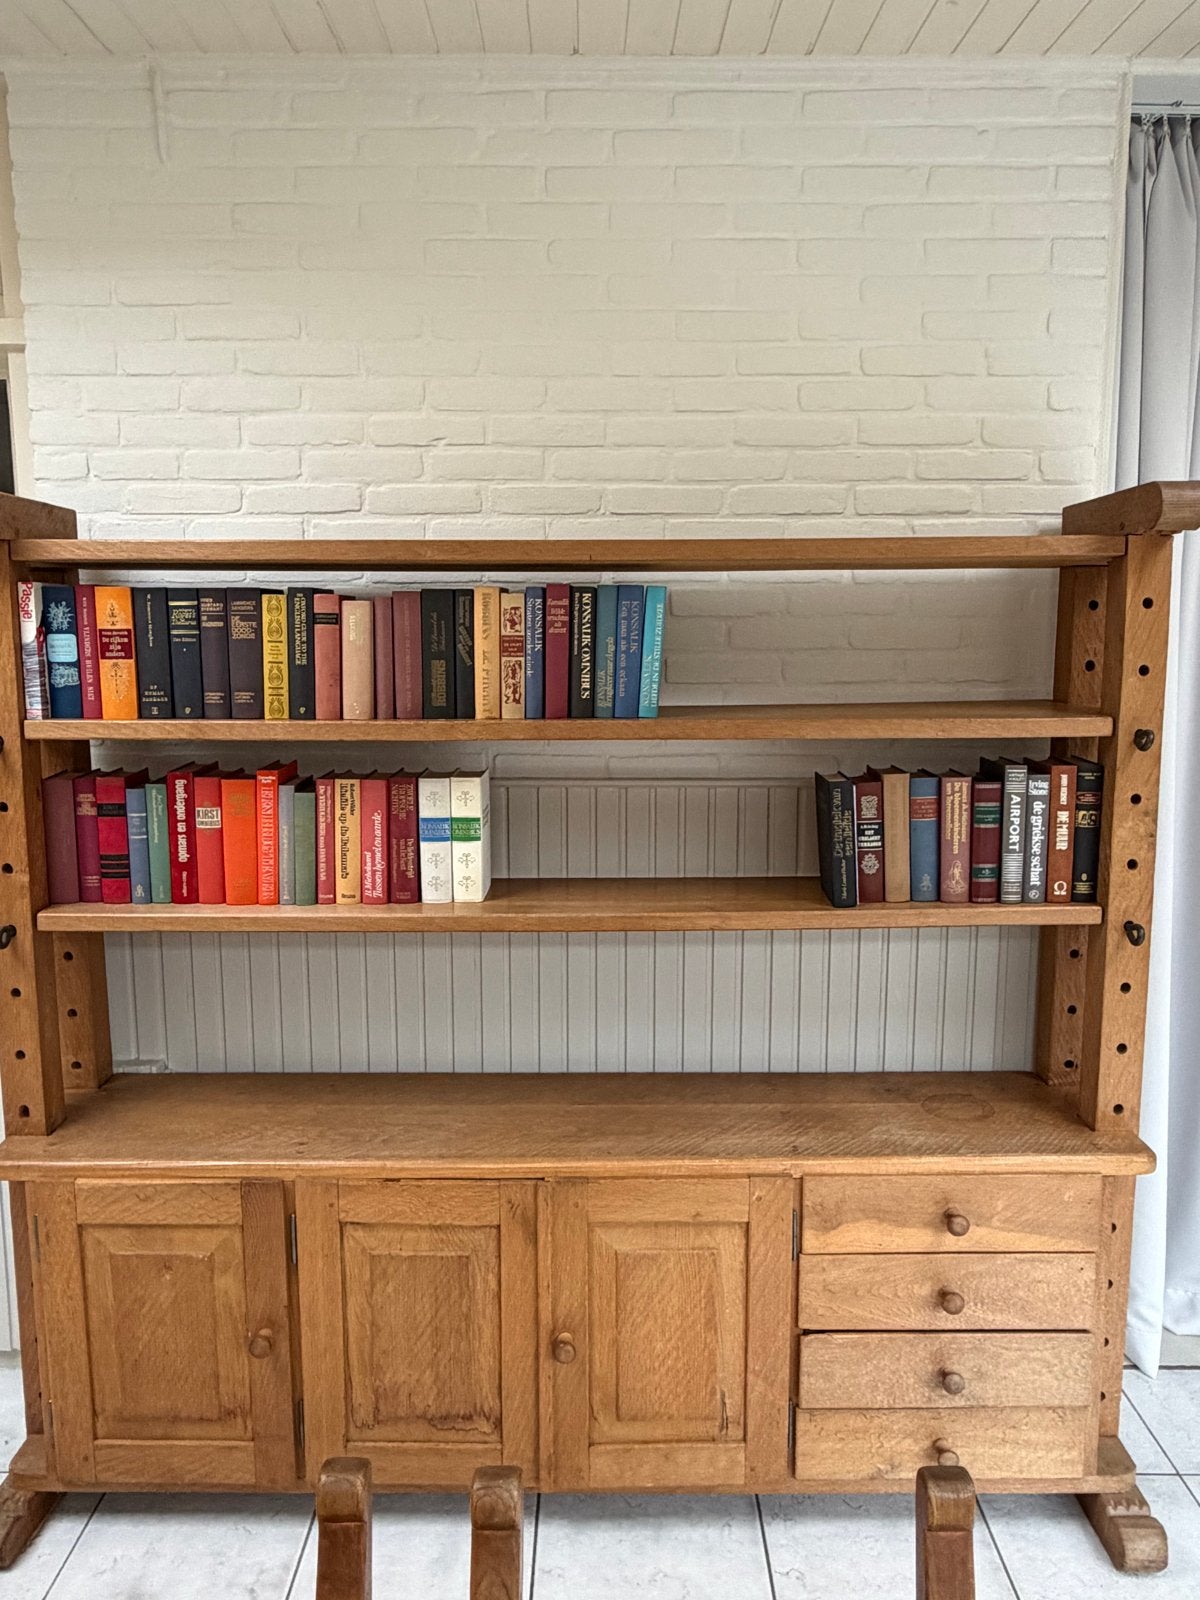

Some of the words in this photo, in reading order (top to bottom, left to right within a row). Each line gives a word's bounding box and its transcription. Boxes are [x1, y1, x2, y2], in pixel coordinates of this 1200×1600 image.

[20, 581, 34, 620] Passie
[535, 598, 543, 652] KONSALIK
[581, 593, 592, 647] KONSALIK
[631, 601, 640, 653] KONSALIK
[581, 647, 591, 699] OMNIBUS
[175, 779, 188, 820] ondergang
[954, 782, 961, 791] De
[197, 808, 219, 820] KIRST
[953, 793, 961, 854] bloemenkinderen
[1009, 794, 1021, 852] AIRPORT
[1033, 800, 1046, 815] de
[1057, 810, 1069, 823] DE
[177, 822, 186, 832] en
[1030, 815, 1045, 855] griekse
[1056, 824, 1069, 850] MUUR
[177, 834, 190, 863] opmars
[373, 871, 382, 898] Tussen
[1030, 855, 1044, 886] schat
